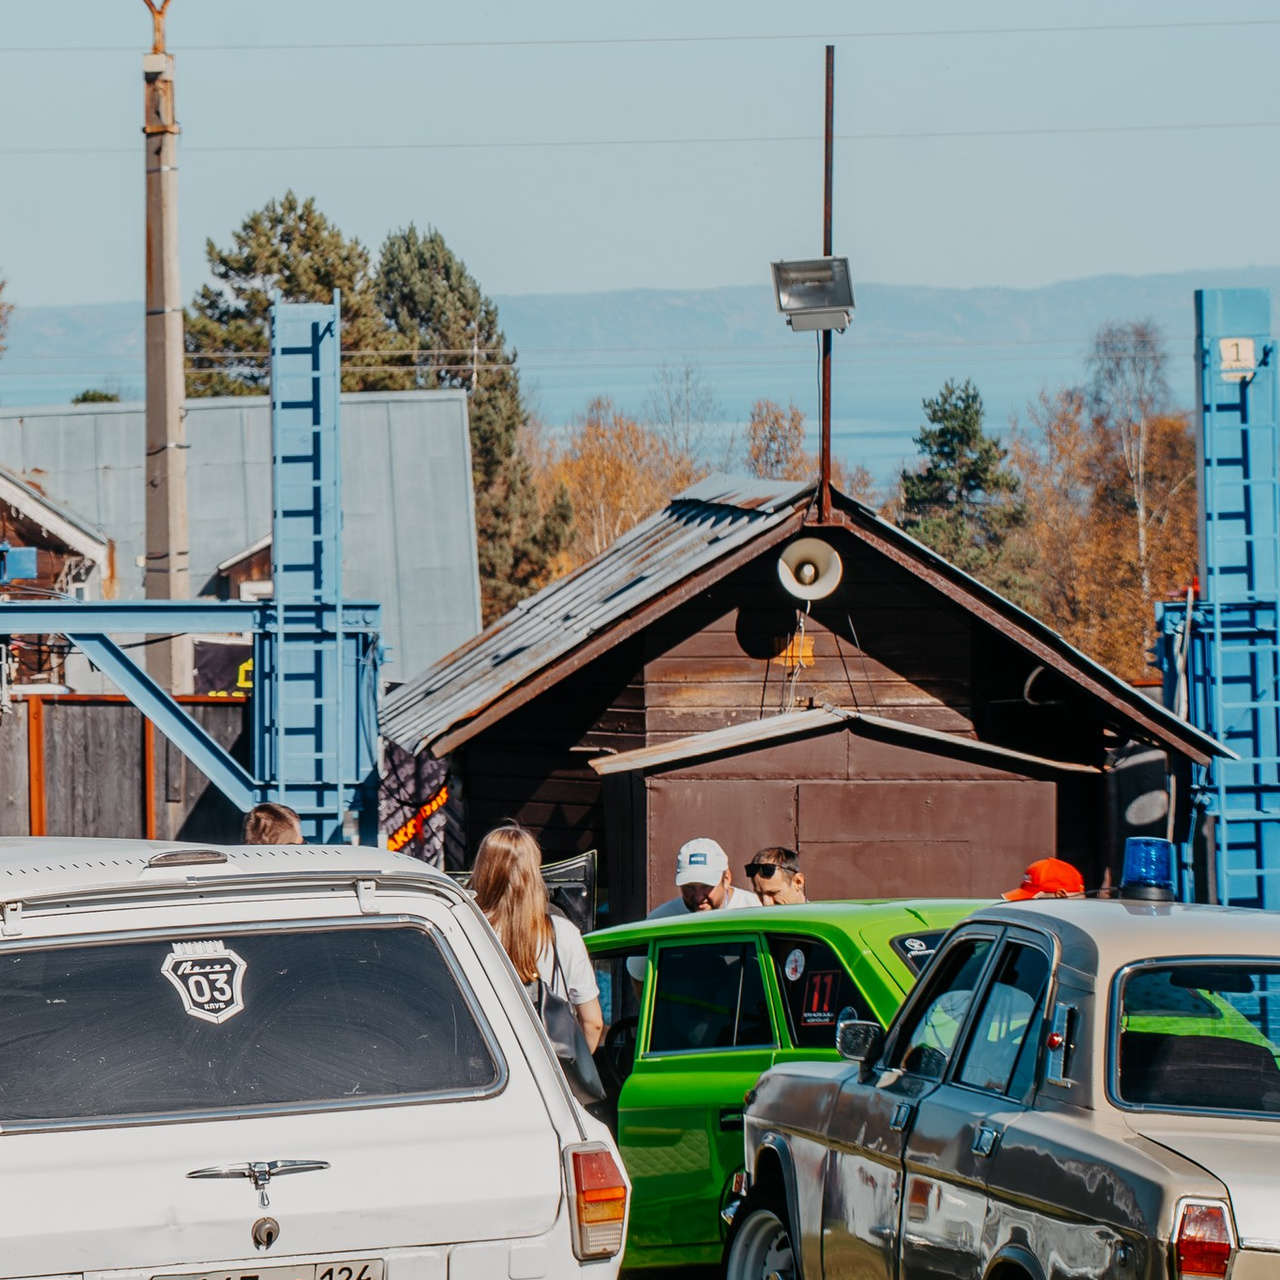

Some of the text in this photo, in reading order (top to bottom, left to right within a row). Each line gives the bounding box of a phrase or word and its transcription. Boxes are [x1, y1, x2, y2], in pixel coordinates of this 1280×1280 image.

[1230, 342, 1241, 362] 1
[188, 973, 232, 1003] 03
[812, 974, 833, 1012] 11
[203, 1002, 226, 1010] КЛУБ
